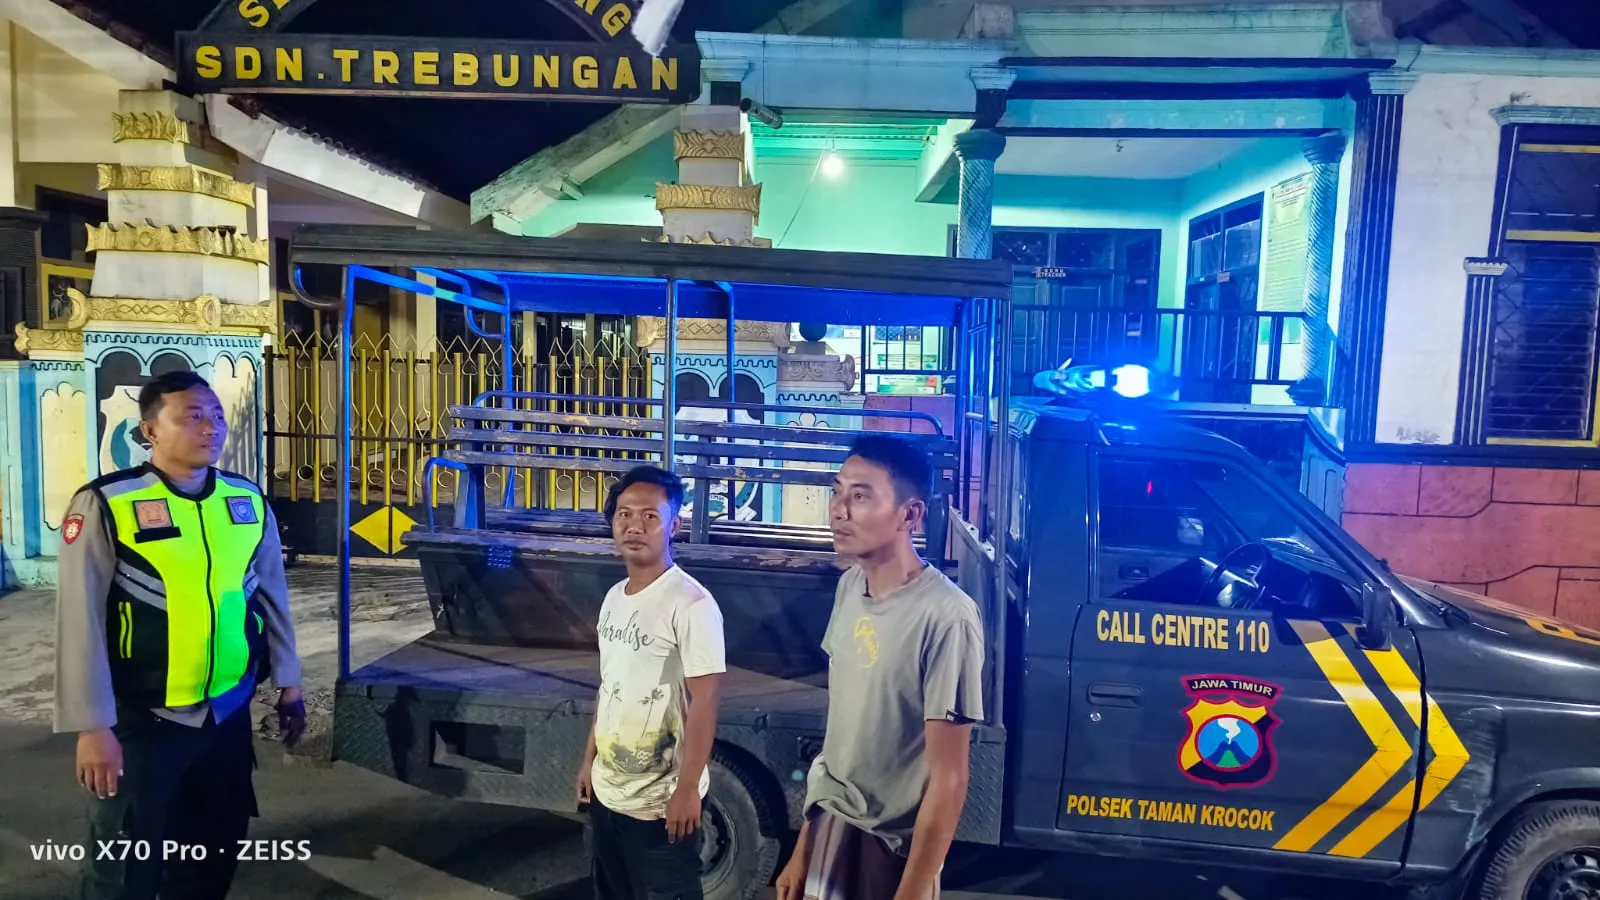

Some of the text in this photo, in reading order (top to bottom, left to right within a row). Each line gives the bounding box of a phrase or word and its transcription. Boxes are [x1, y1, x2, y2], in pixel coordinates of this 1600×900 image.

[1096, 609, 1270, 653] CALL CENTRE 110
[1191, 679, 1273, 696] JAWA TIMUR
[1066, 794, 1276, 831] POLSEK TAMAN KROCOK
